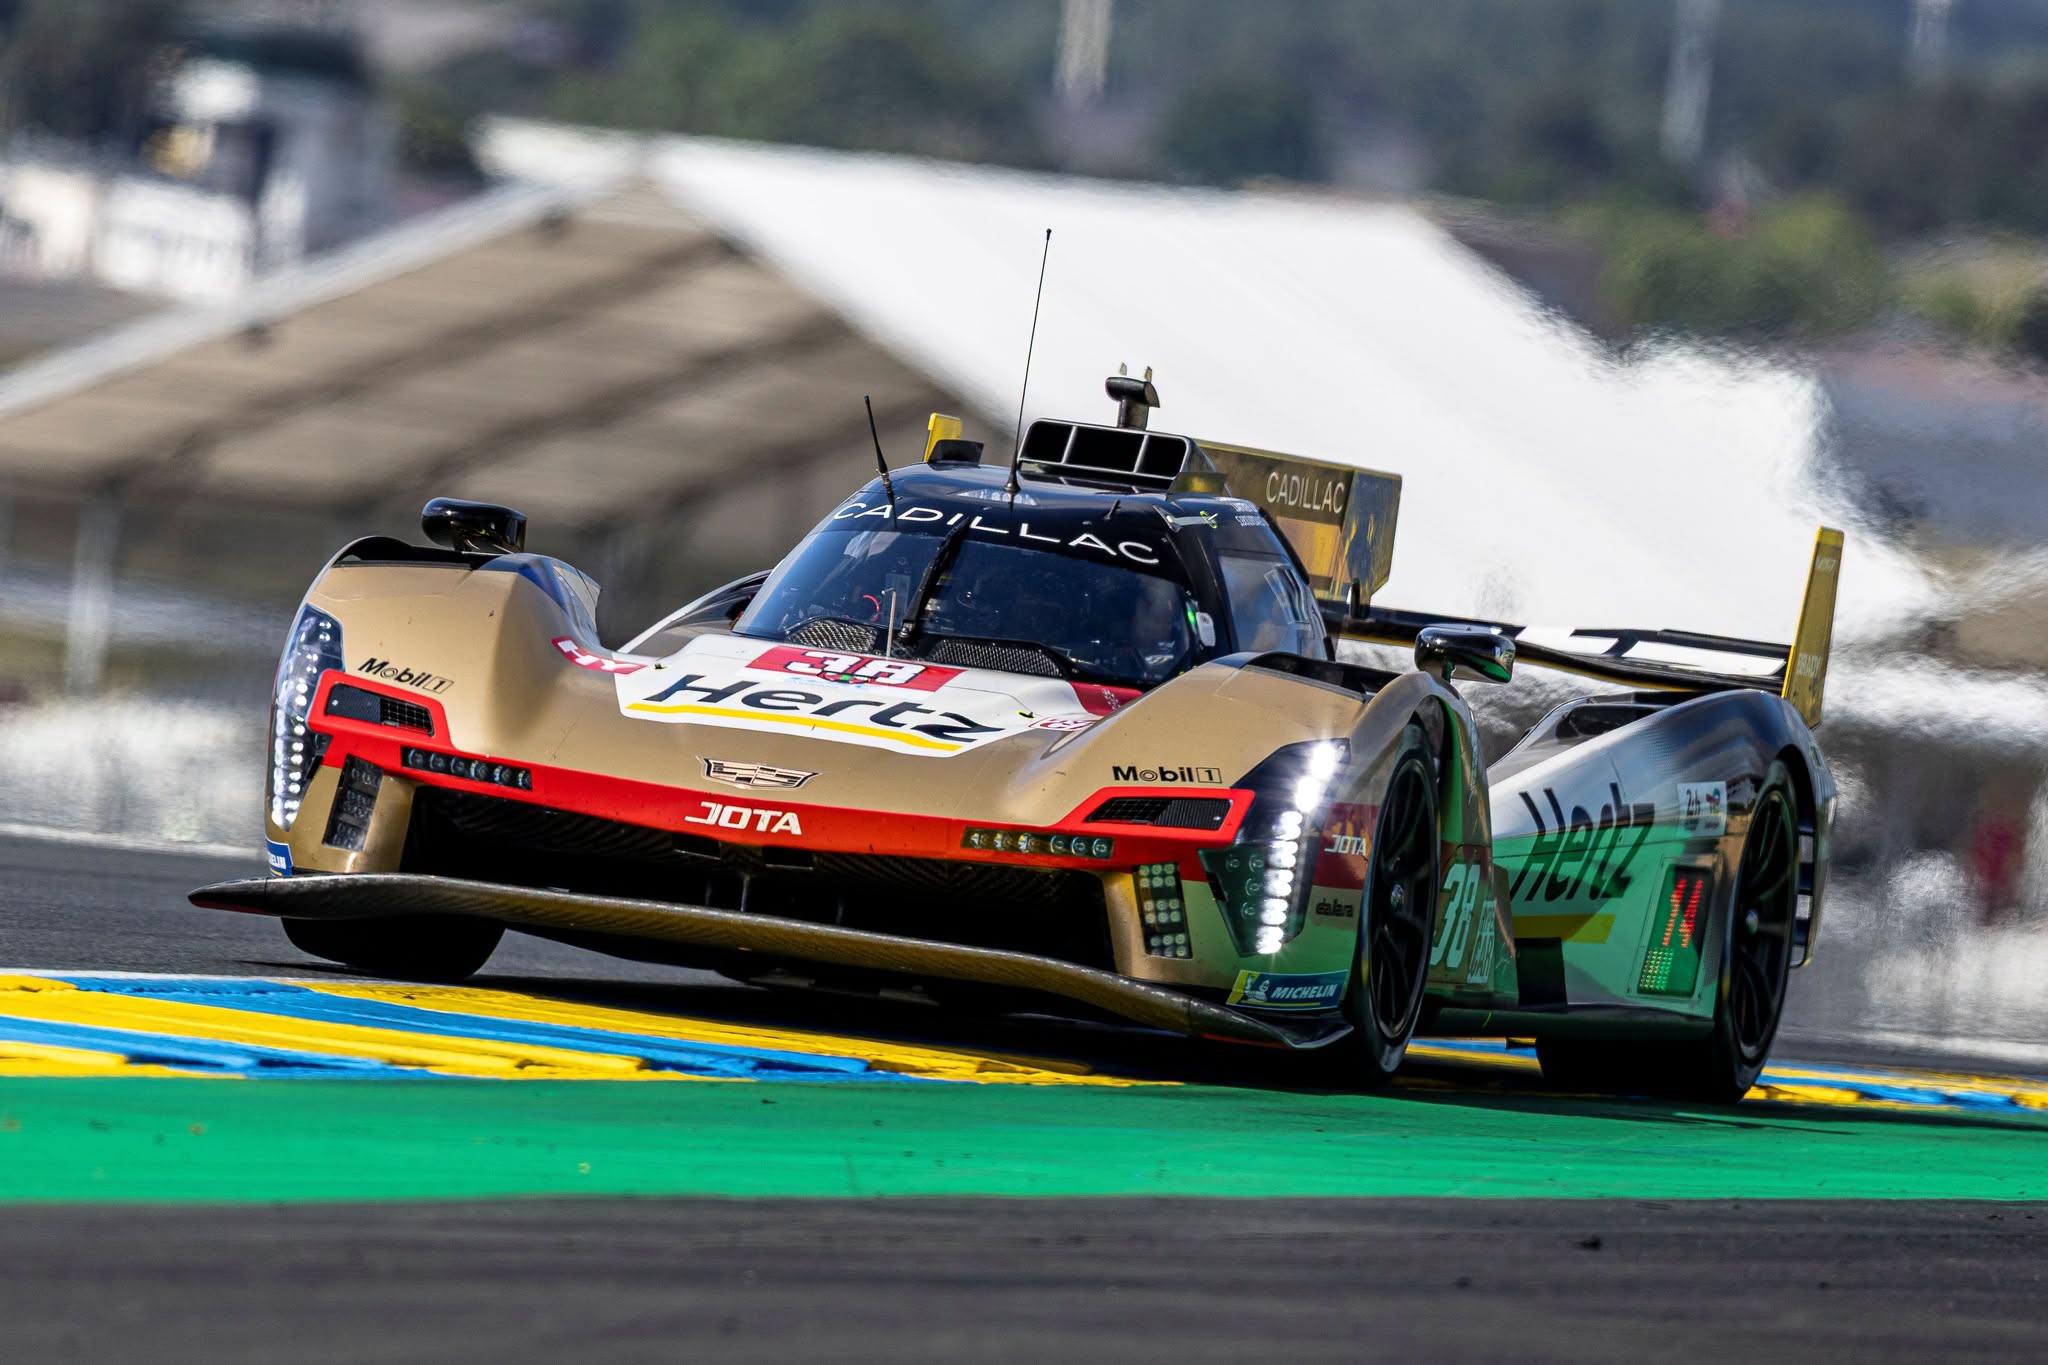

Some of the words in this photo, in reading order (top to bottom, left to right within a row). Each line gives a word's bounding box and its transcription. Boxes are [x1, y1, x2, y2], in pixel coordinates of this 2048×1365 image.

[1266, 471, 1345, 514] CADILLAC
[833, 503, 1159, 564] CADILLAC
[358, 658, 432, 687] Mobil
[784, 651, 928, 685] 38
[643, 674, 1006, 743] Hertz
[1112, 766, 1194, 782] Mobil
[685, 801, 802, 835] JOTA
[1324, 834, 1367, 856] JOTA
[1507, 782, 1655, 901] Hertz
[1429, 863, 1481, 968] 38
[1271, 984, 1338, 999] MICHELIN
